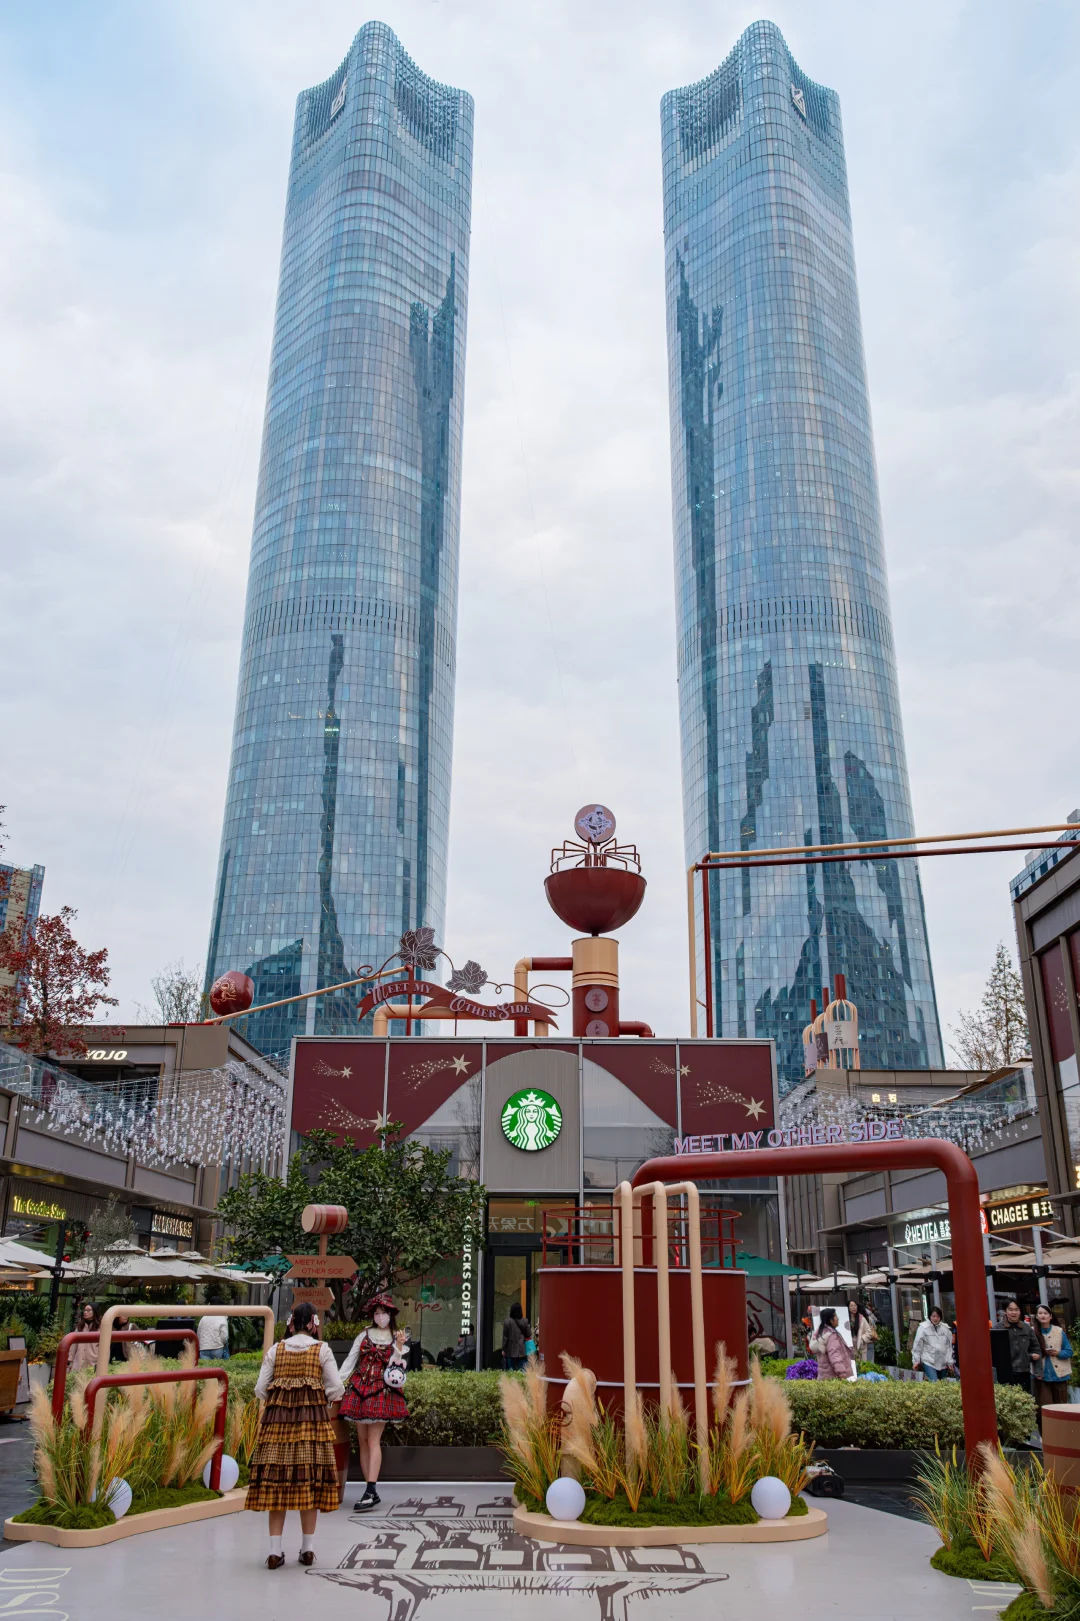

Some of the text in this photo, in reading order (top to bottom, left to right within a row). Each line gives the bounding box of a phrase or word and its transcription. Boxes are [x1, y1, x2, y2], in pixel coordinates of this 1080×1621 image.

[414, 983, 433, 994] MY
[673, 1119, 904, 1154] MEET MY OTHER SIDE
[991, 1203, 1029, 1225] CHAGEE
[911, 1221, 939, 1242] HEYTEA
[461, 1282, 472, 1335] COFFEE
